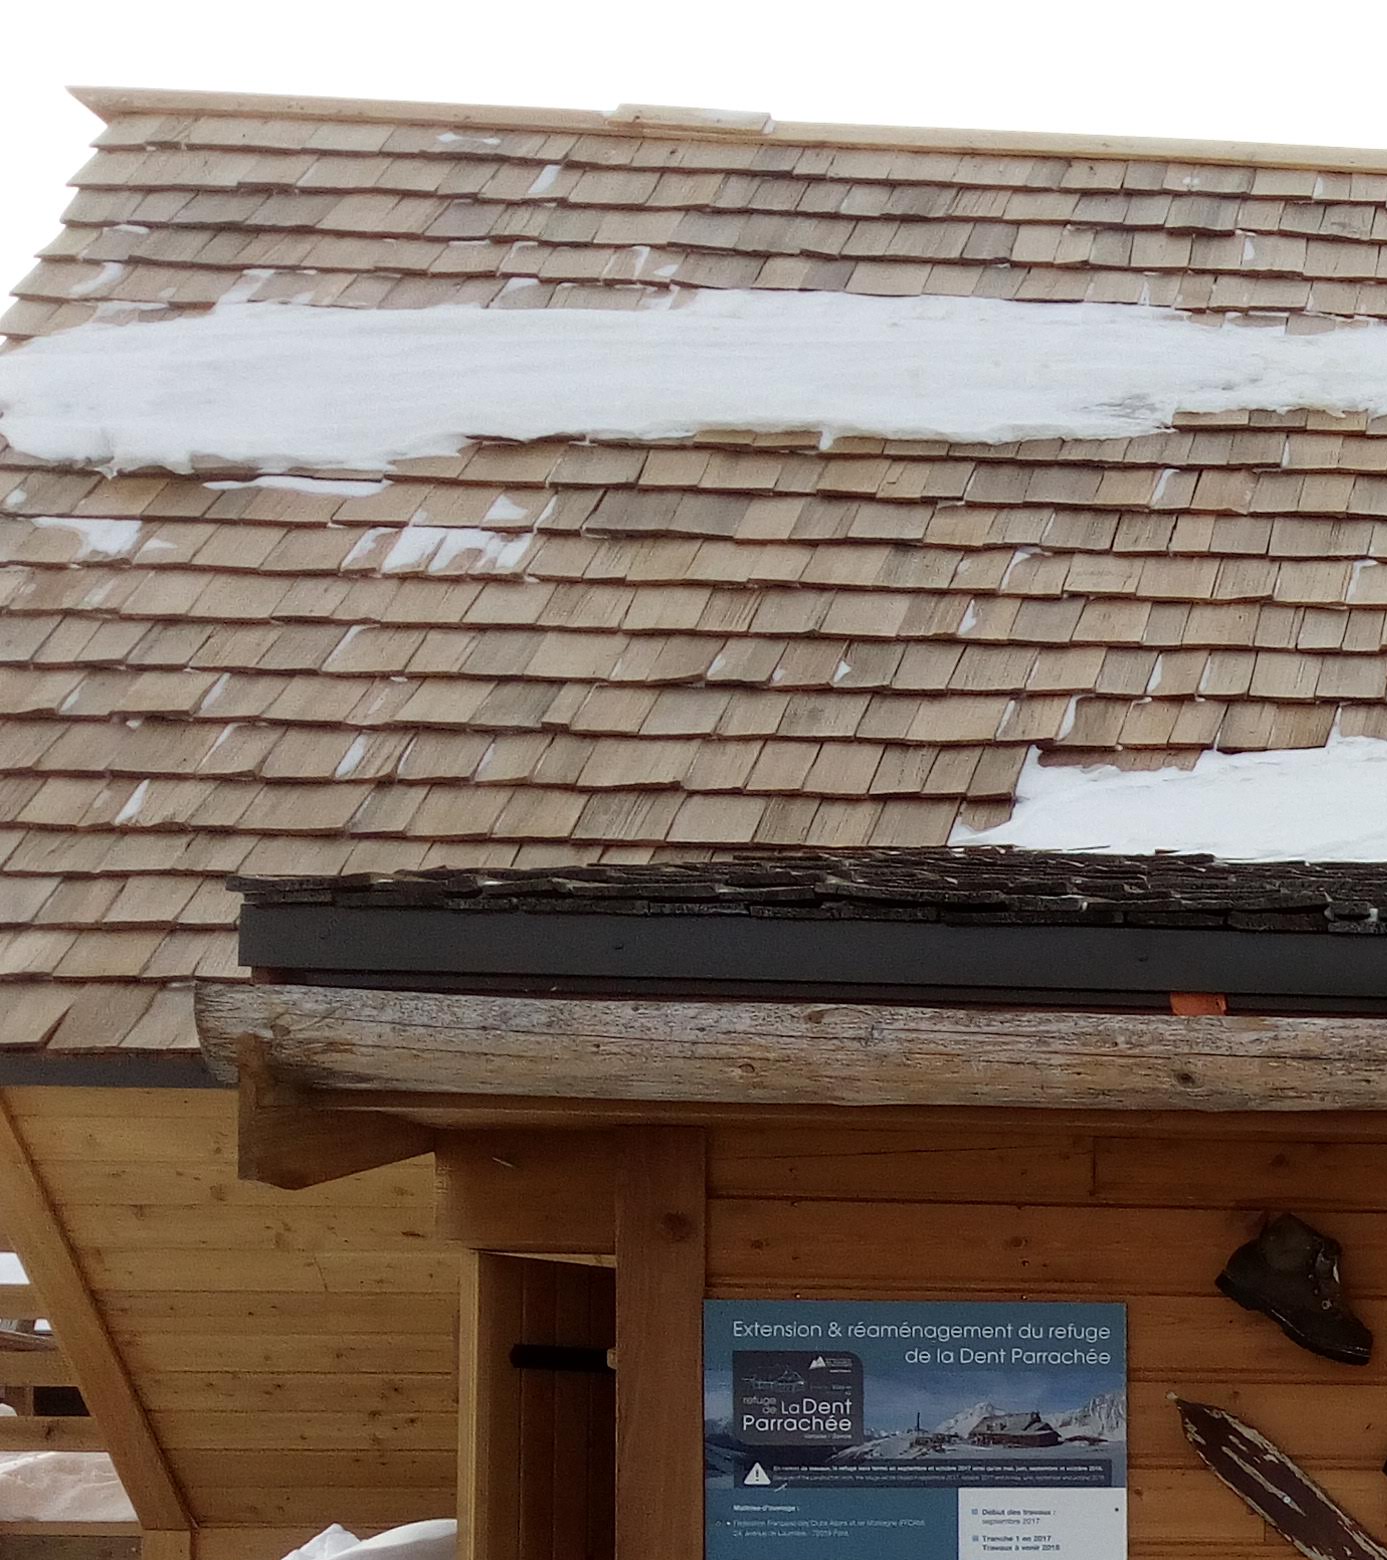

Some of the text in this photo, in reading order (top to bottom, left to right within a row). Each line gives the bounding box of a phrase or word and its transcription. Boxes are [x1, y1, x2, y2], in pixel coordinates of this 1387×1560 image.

[732, 1320, 1111, 1343] Extension & réaménagement du refuge
[904, 1348, 1112, 1365] de la Dent Parrachée
[742, 1395, 777, 1415] refuge de
[781, 1398, 853, 1415] La Dent
[742, 1414, 852, 1432] Parrachée
